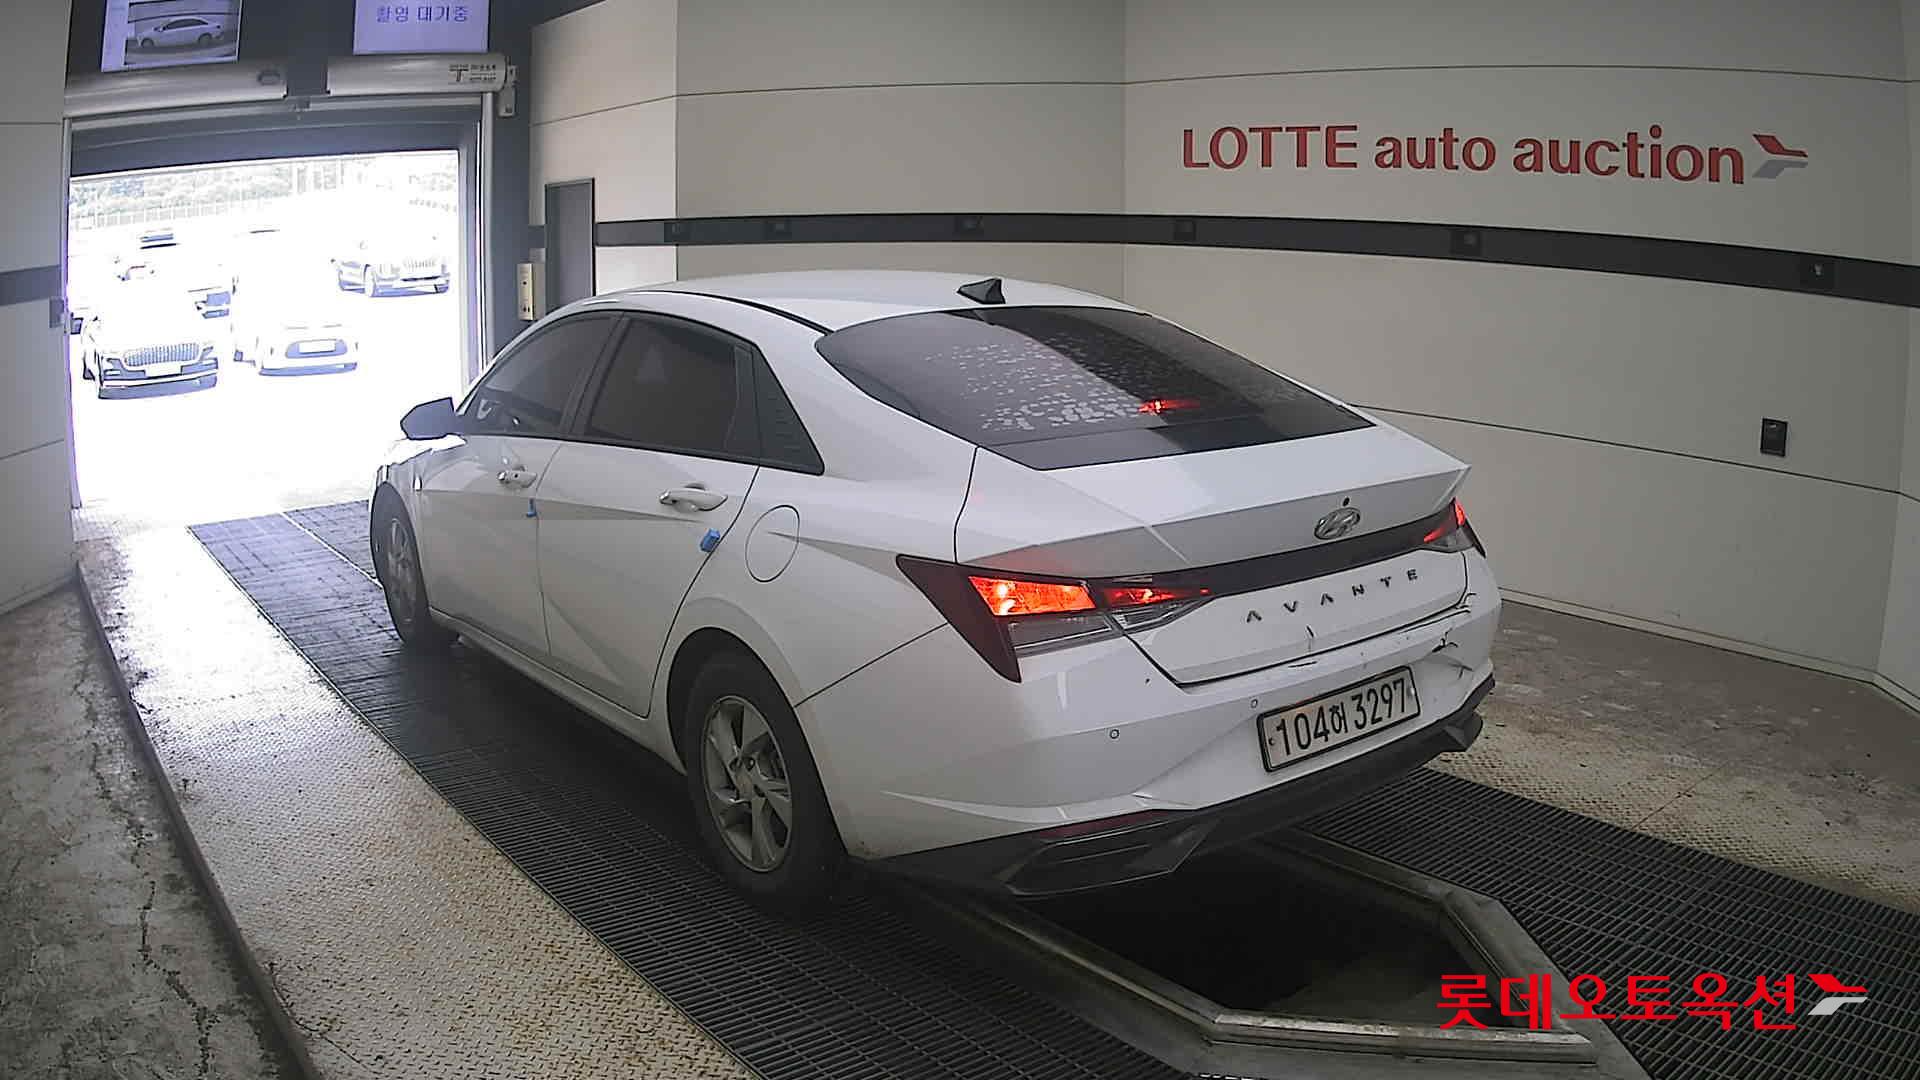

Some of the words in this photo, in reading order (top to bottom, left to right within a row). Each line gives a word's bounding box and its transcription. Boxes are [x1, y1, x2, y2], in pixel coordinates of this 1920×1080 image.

[417, 5, 468, 23] 대기중
[1183, 126, 1358, 169] LOTTE
[1375, 127, 1497, 171] auto
[1513, 125, 1744, 184] auction
[1246, 569, 1418, 623] AVANTE
[1352, 677, 1407, 730] 3297
